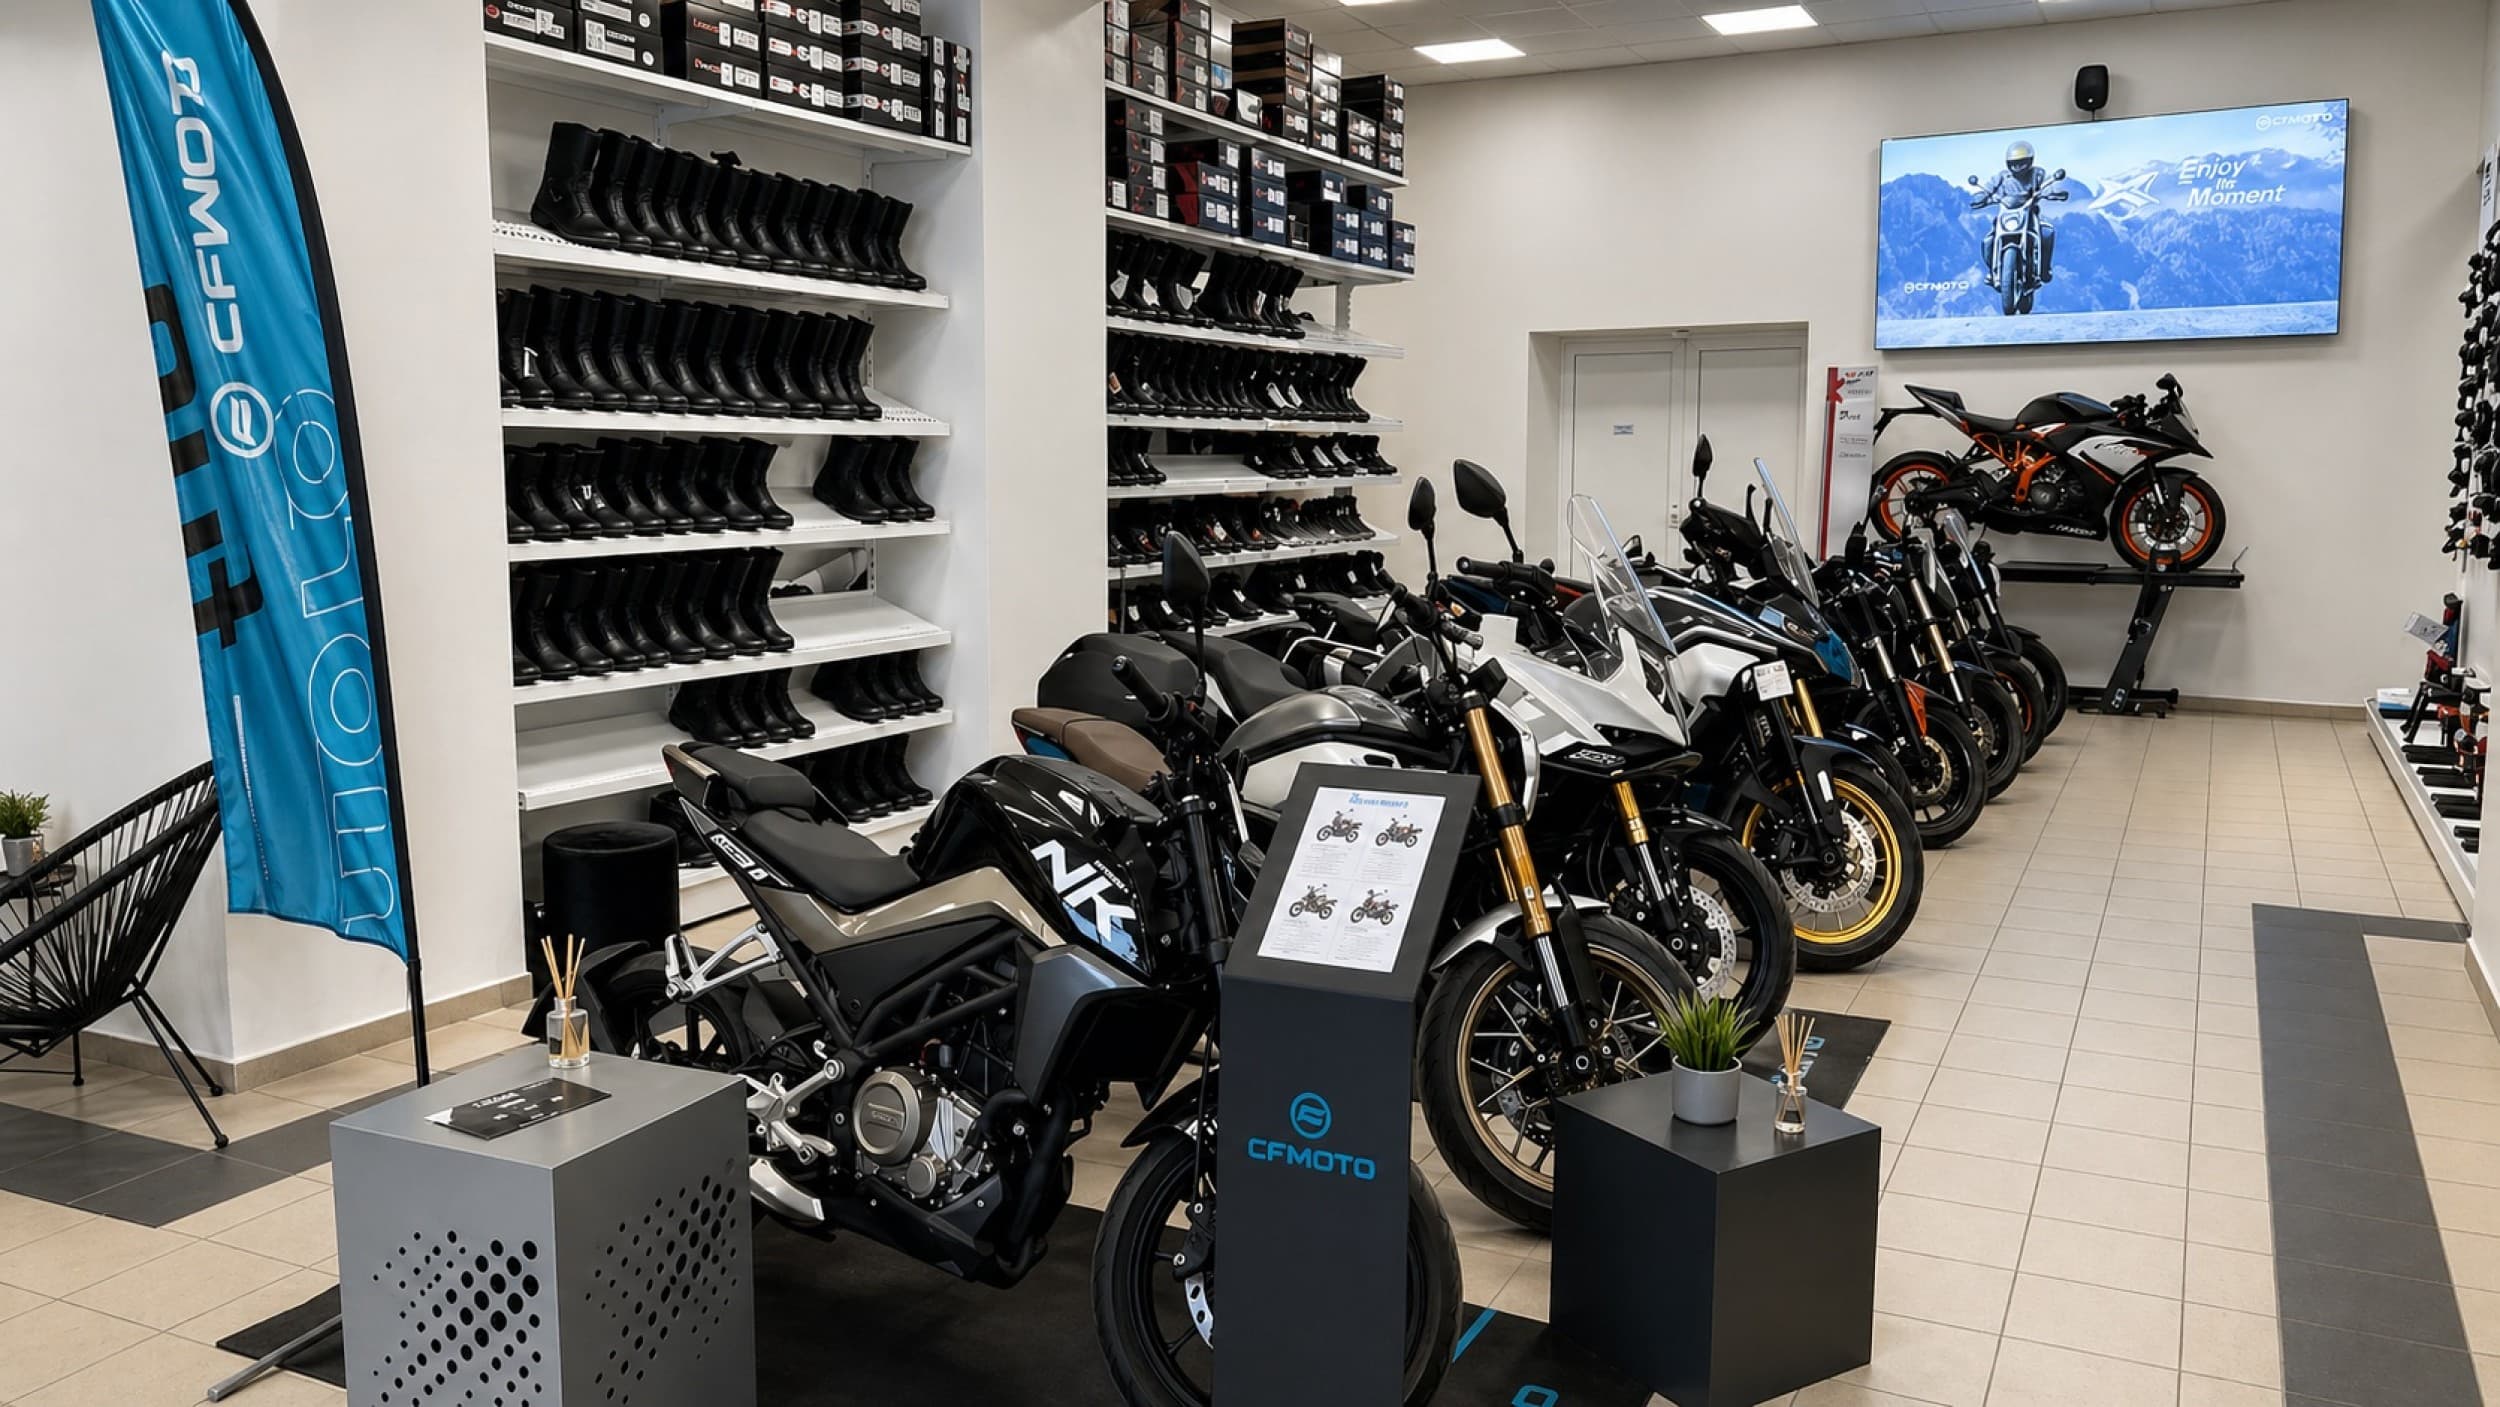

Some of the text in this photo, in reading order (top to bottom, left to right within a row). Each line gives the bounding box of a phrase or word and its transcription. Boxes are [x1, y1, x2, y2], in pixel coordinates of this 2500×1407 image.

[2178, 158, 2247, 180] Enjoy
[2186, 184, 2287, 208] Moment
[1030, 839, 1137, 942] NK
[1247, 1137, 1377, 1180] CFMOTO
